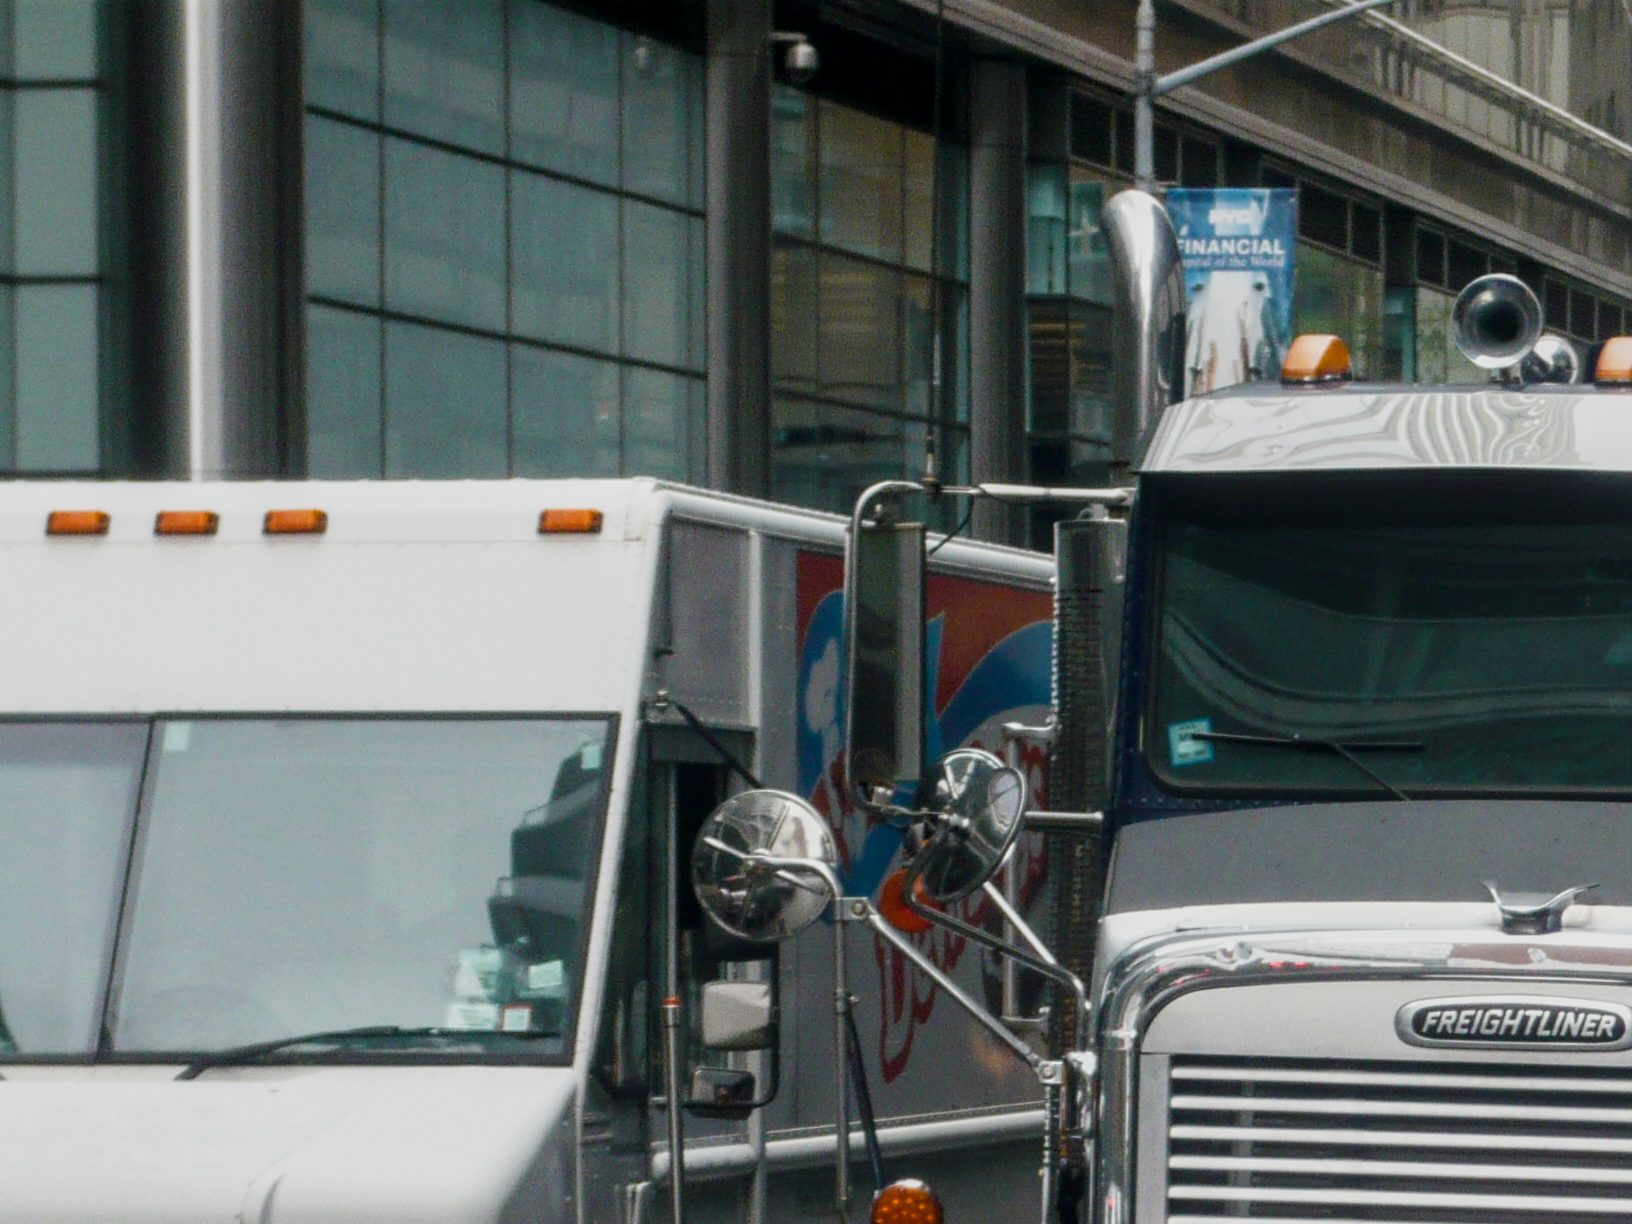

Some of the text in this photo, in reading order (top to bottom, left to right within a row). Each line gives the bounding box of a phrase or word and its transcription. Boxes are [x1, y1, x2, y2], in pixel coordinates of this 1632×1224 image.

[1177, 239, 1285, 255] FINANCIAL
[1230, 256, 1247, 267] the
[1251, 256, 1285, 268] World
[1421, 1009, 1617, 1039] FREIGHTLINER
